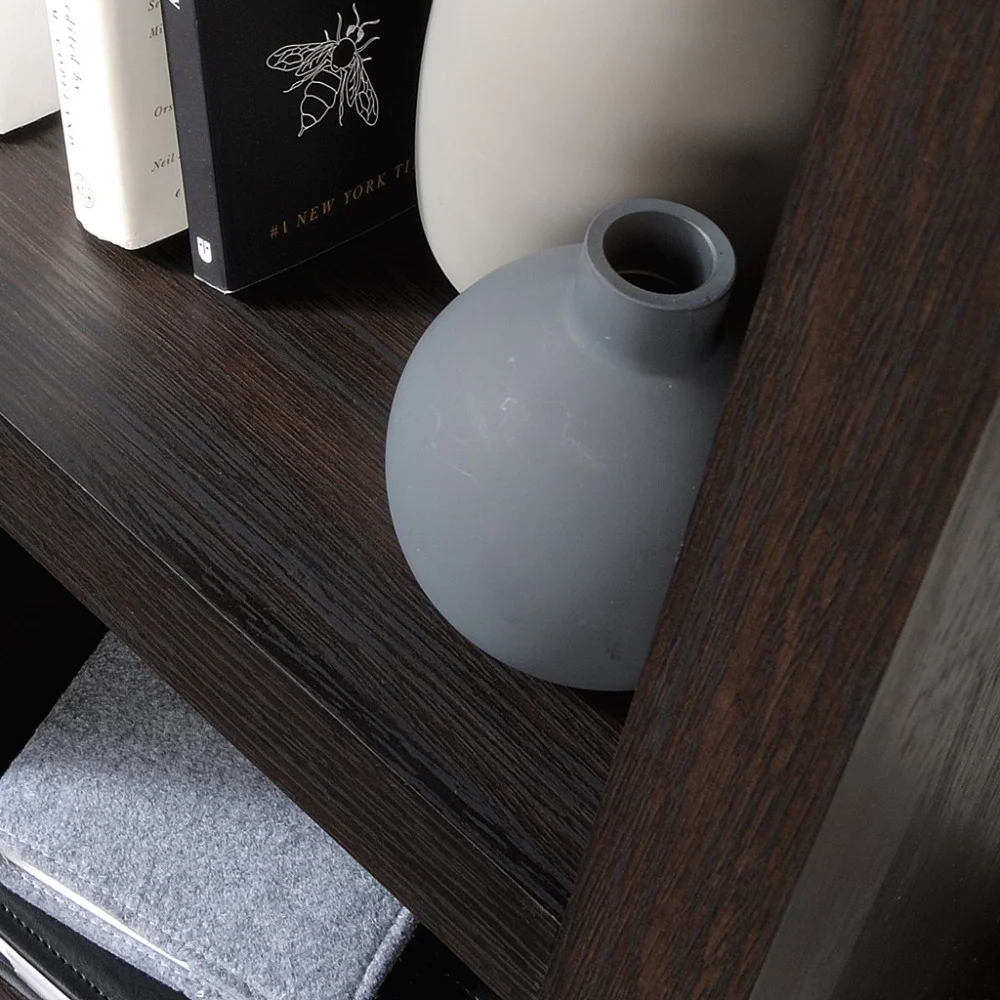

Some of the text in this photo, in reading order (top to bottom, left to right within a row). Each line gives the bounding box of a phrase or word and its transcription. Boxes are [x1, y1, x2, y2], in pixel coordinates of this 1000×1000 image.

[150, 152, 175, 173] Neil
[268, 159, 416, 240] #1 NEW YORK TI
